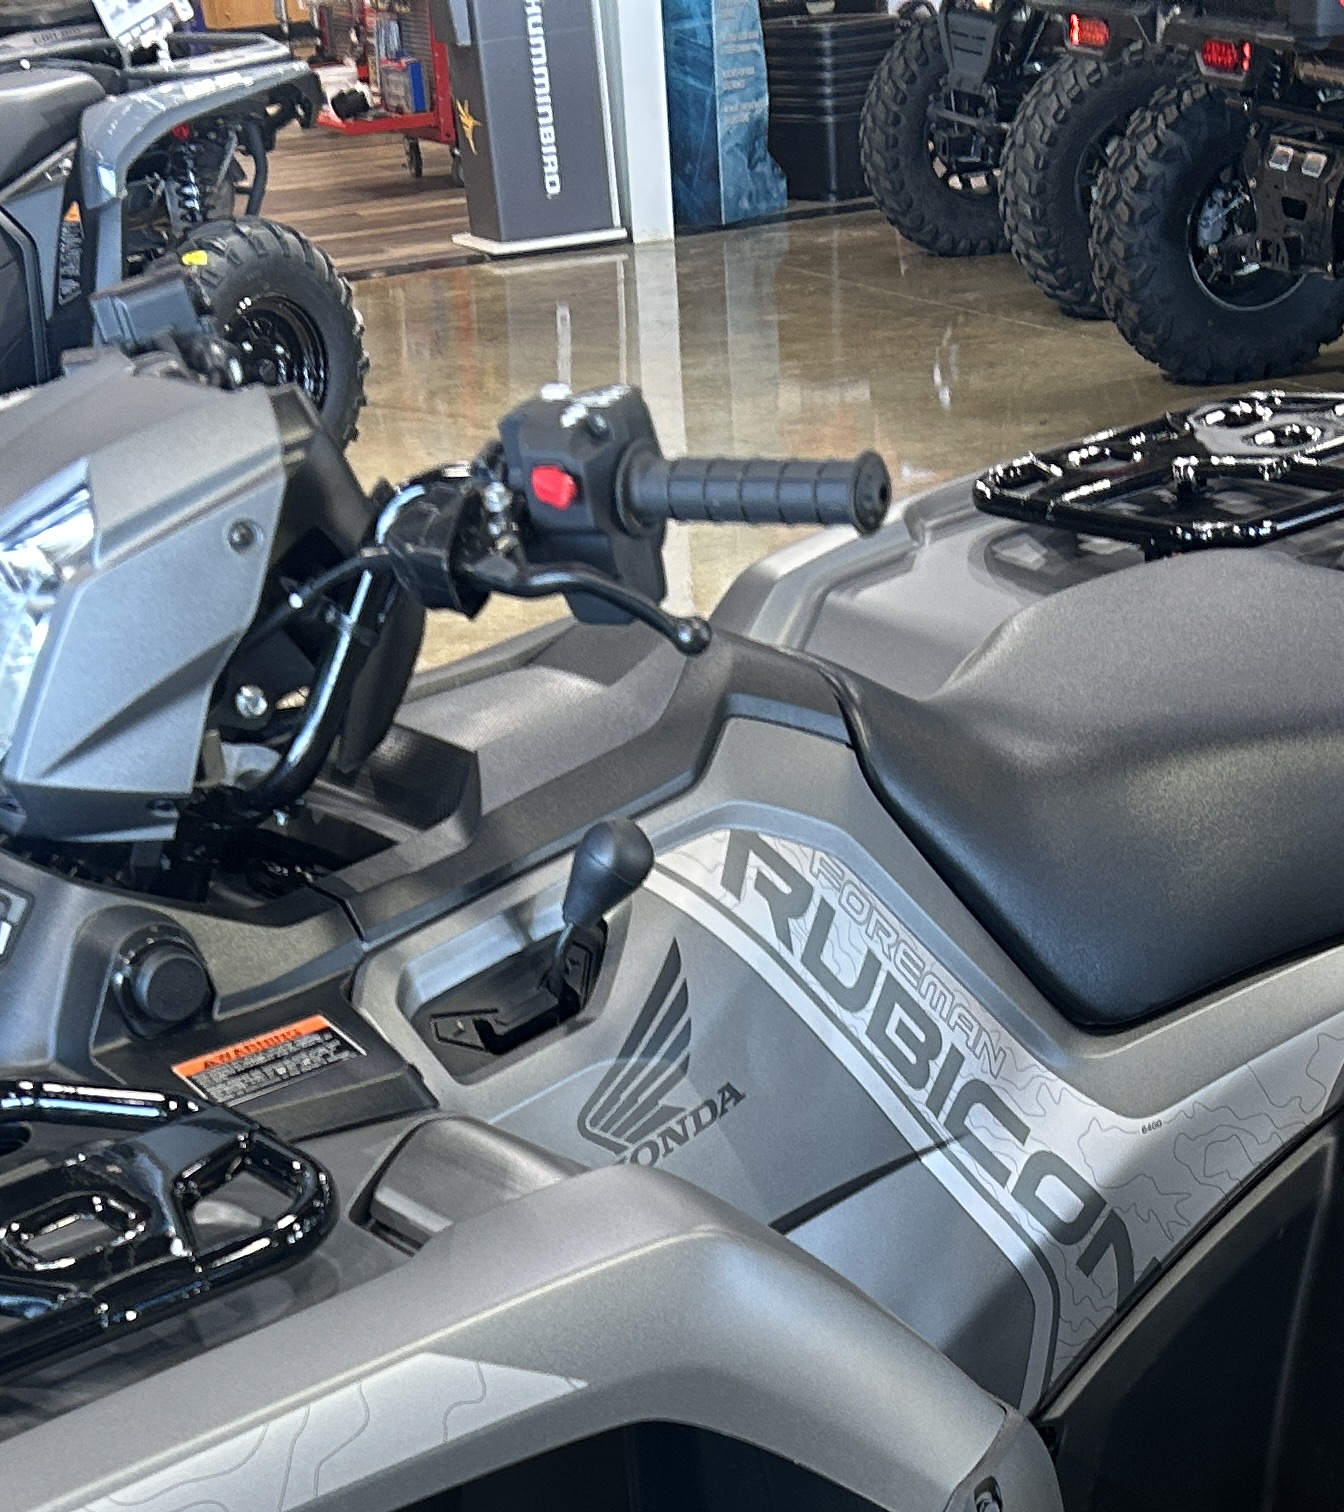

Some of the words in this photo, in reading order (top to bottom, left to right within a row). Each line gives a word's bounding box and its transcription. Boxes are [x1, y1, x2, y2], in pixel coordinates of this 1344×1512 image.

[719, 829, 1164, 1313] RUBICON
[808, 848, 1007, 1079] FOREMAN
[614, 1081, 747, 1168] ONDA
